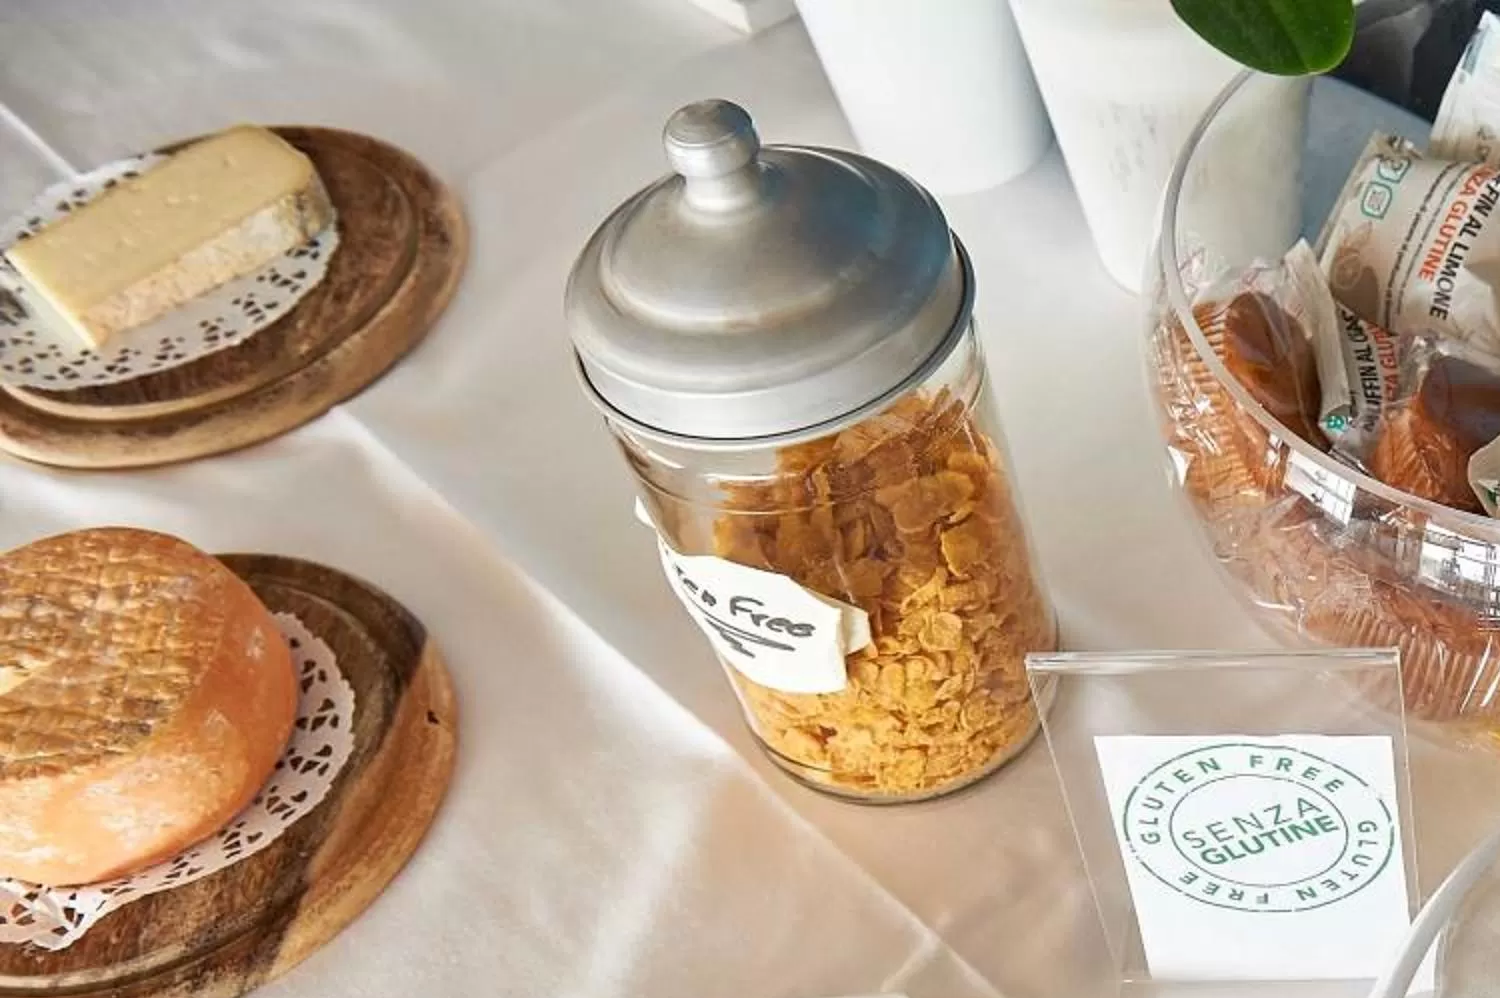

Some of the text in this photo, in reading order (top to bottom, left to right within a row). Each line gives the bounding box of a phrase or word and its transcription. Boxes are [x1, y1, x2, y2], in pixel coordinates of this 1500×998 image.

[1417, 198, 1469, 283] GLUTINE
[1458, 215, 1483, 241] AL
[1428, 242, 1470, 321] LIMONE
[729, 595, 816, 637] Free
[1140, 754, 1378, 905] GLUTEN FREE GLUTEN FREE
[1182, 796, 1323, 849] SENZA
[1200, 814, 1340, 865] GLUTINE
